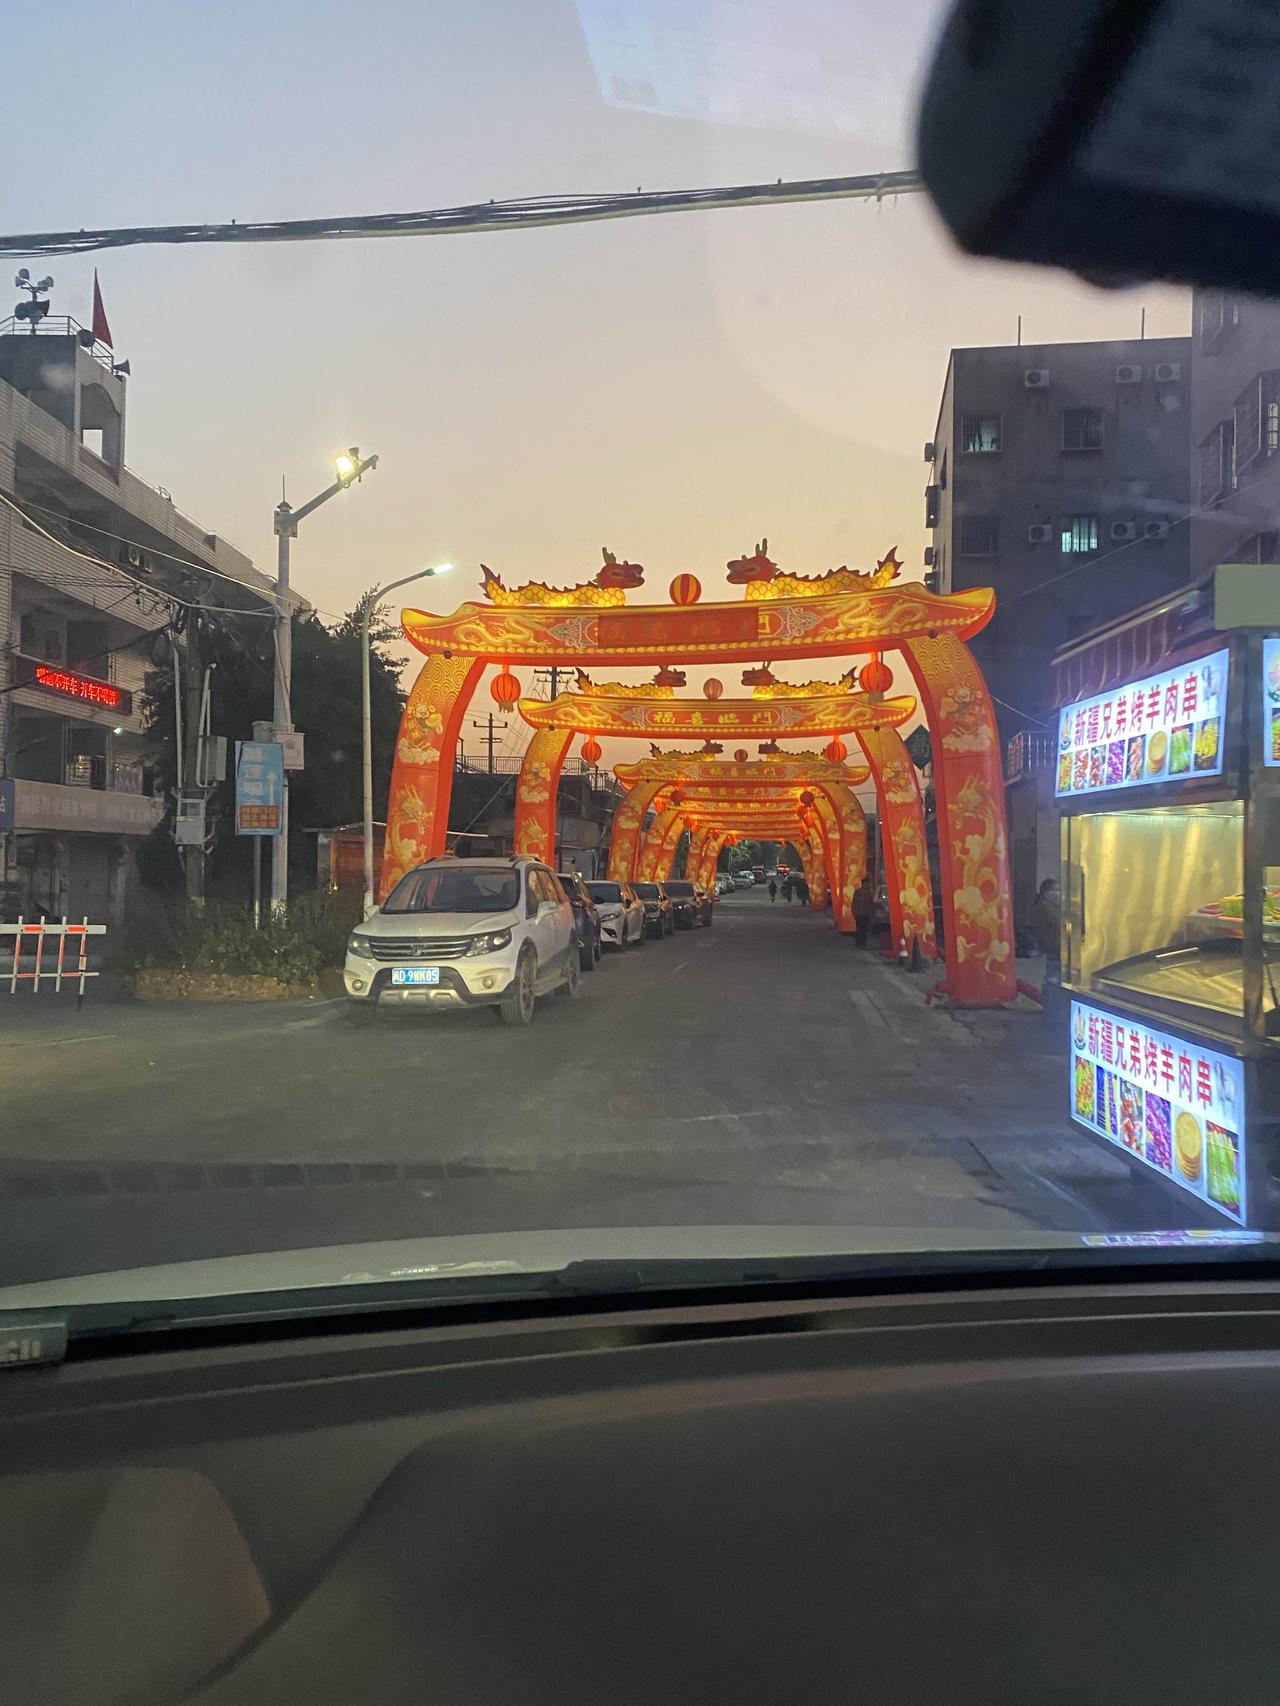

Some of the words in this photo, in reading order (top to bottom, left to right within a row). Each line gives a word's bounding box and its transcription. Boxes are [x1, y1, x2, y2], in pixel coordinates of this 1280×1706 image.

[1074, 671, 1198, 746] 新疆兄弟烤羊肉串
[1088, 1012, 1212, 1110] 新疆兄弟烤羊肉串
